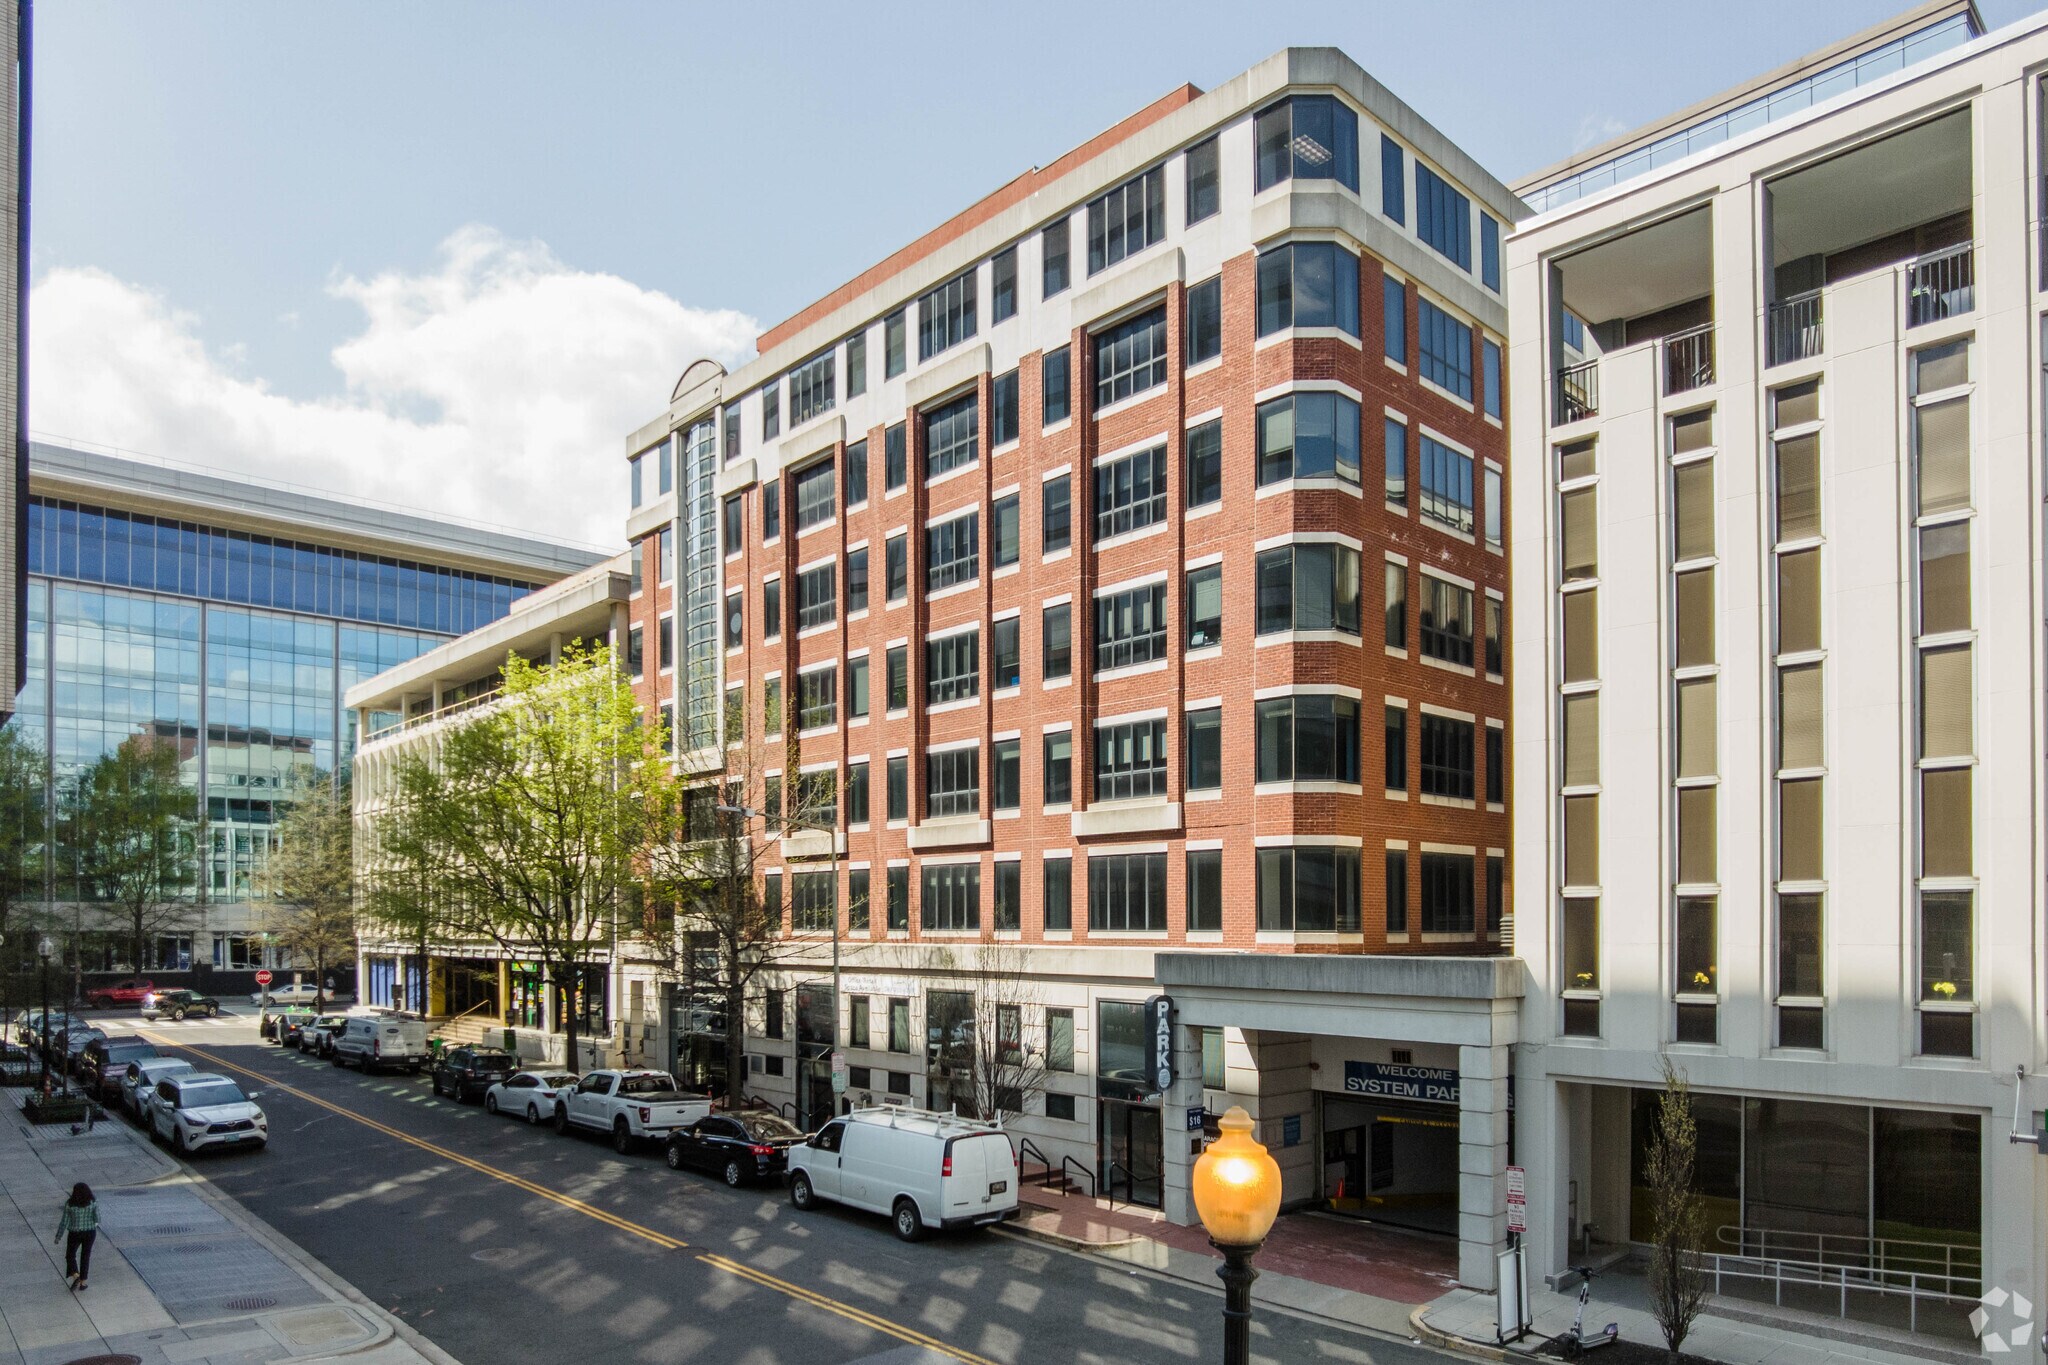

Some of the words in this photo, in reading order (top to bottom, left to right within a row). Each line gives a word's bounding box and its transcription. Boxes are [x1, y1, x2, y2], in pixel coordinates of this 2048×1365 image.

[1156, 1001, 1170, 1067] PARK
[1377, 1065, 1453, 1081] WELCOME
[1347, 1077, 1419, 1097] SYSTEM
[1189, 1115, 1201, 1127] $16
